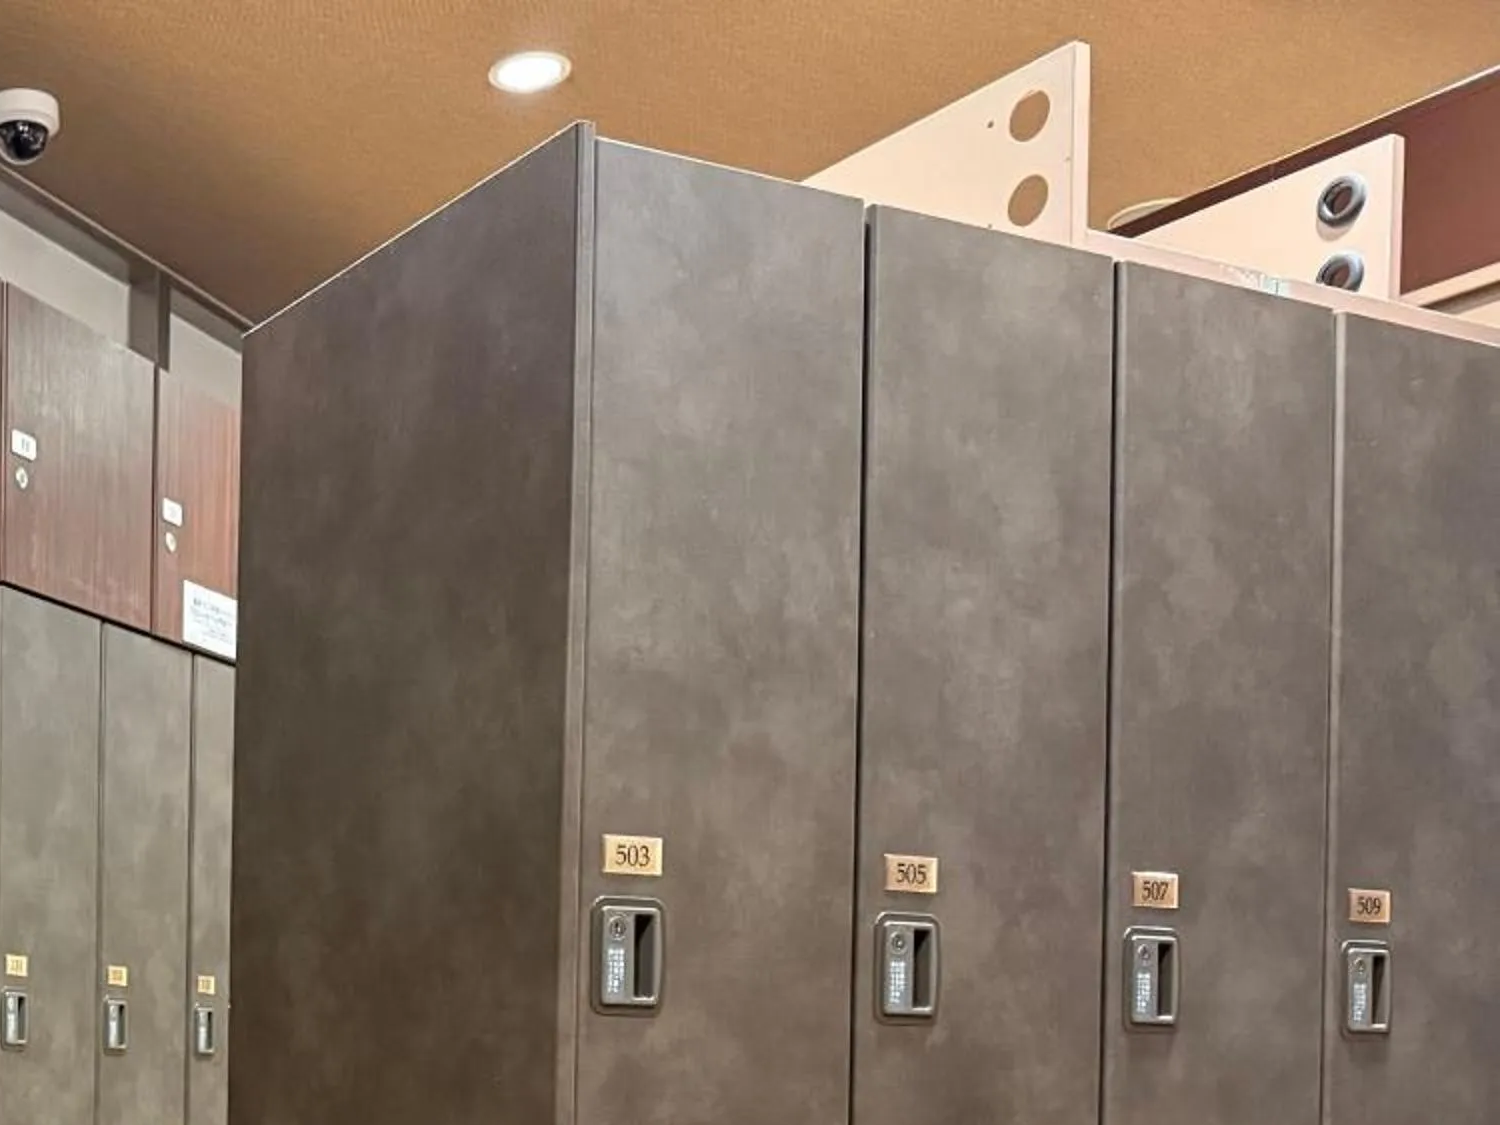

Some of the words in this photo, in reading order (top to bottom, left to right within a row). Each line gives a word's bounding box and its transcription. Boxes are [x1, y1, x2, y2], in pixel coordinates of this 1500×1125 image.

[615, 844, 650, 867] 503
[895, 863, 927, 885] 505
[1141, 880, 1169, 901] 507
[1356, 896, 1382, 915] 509
